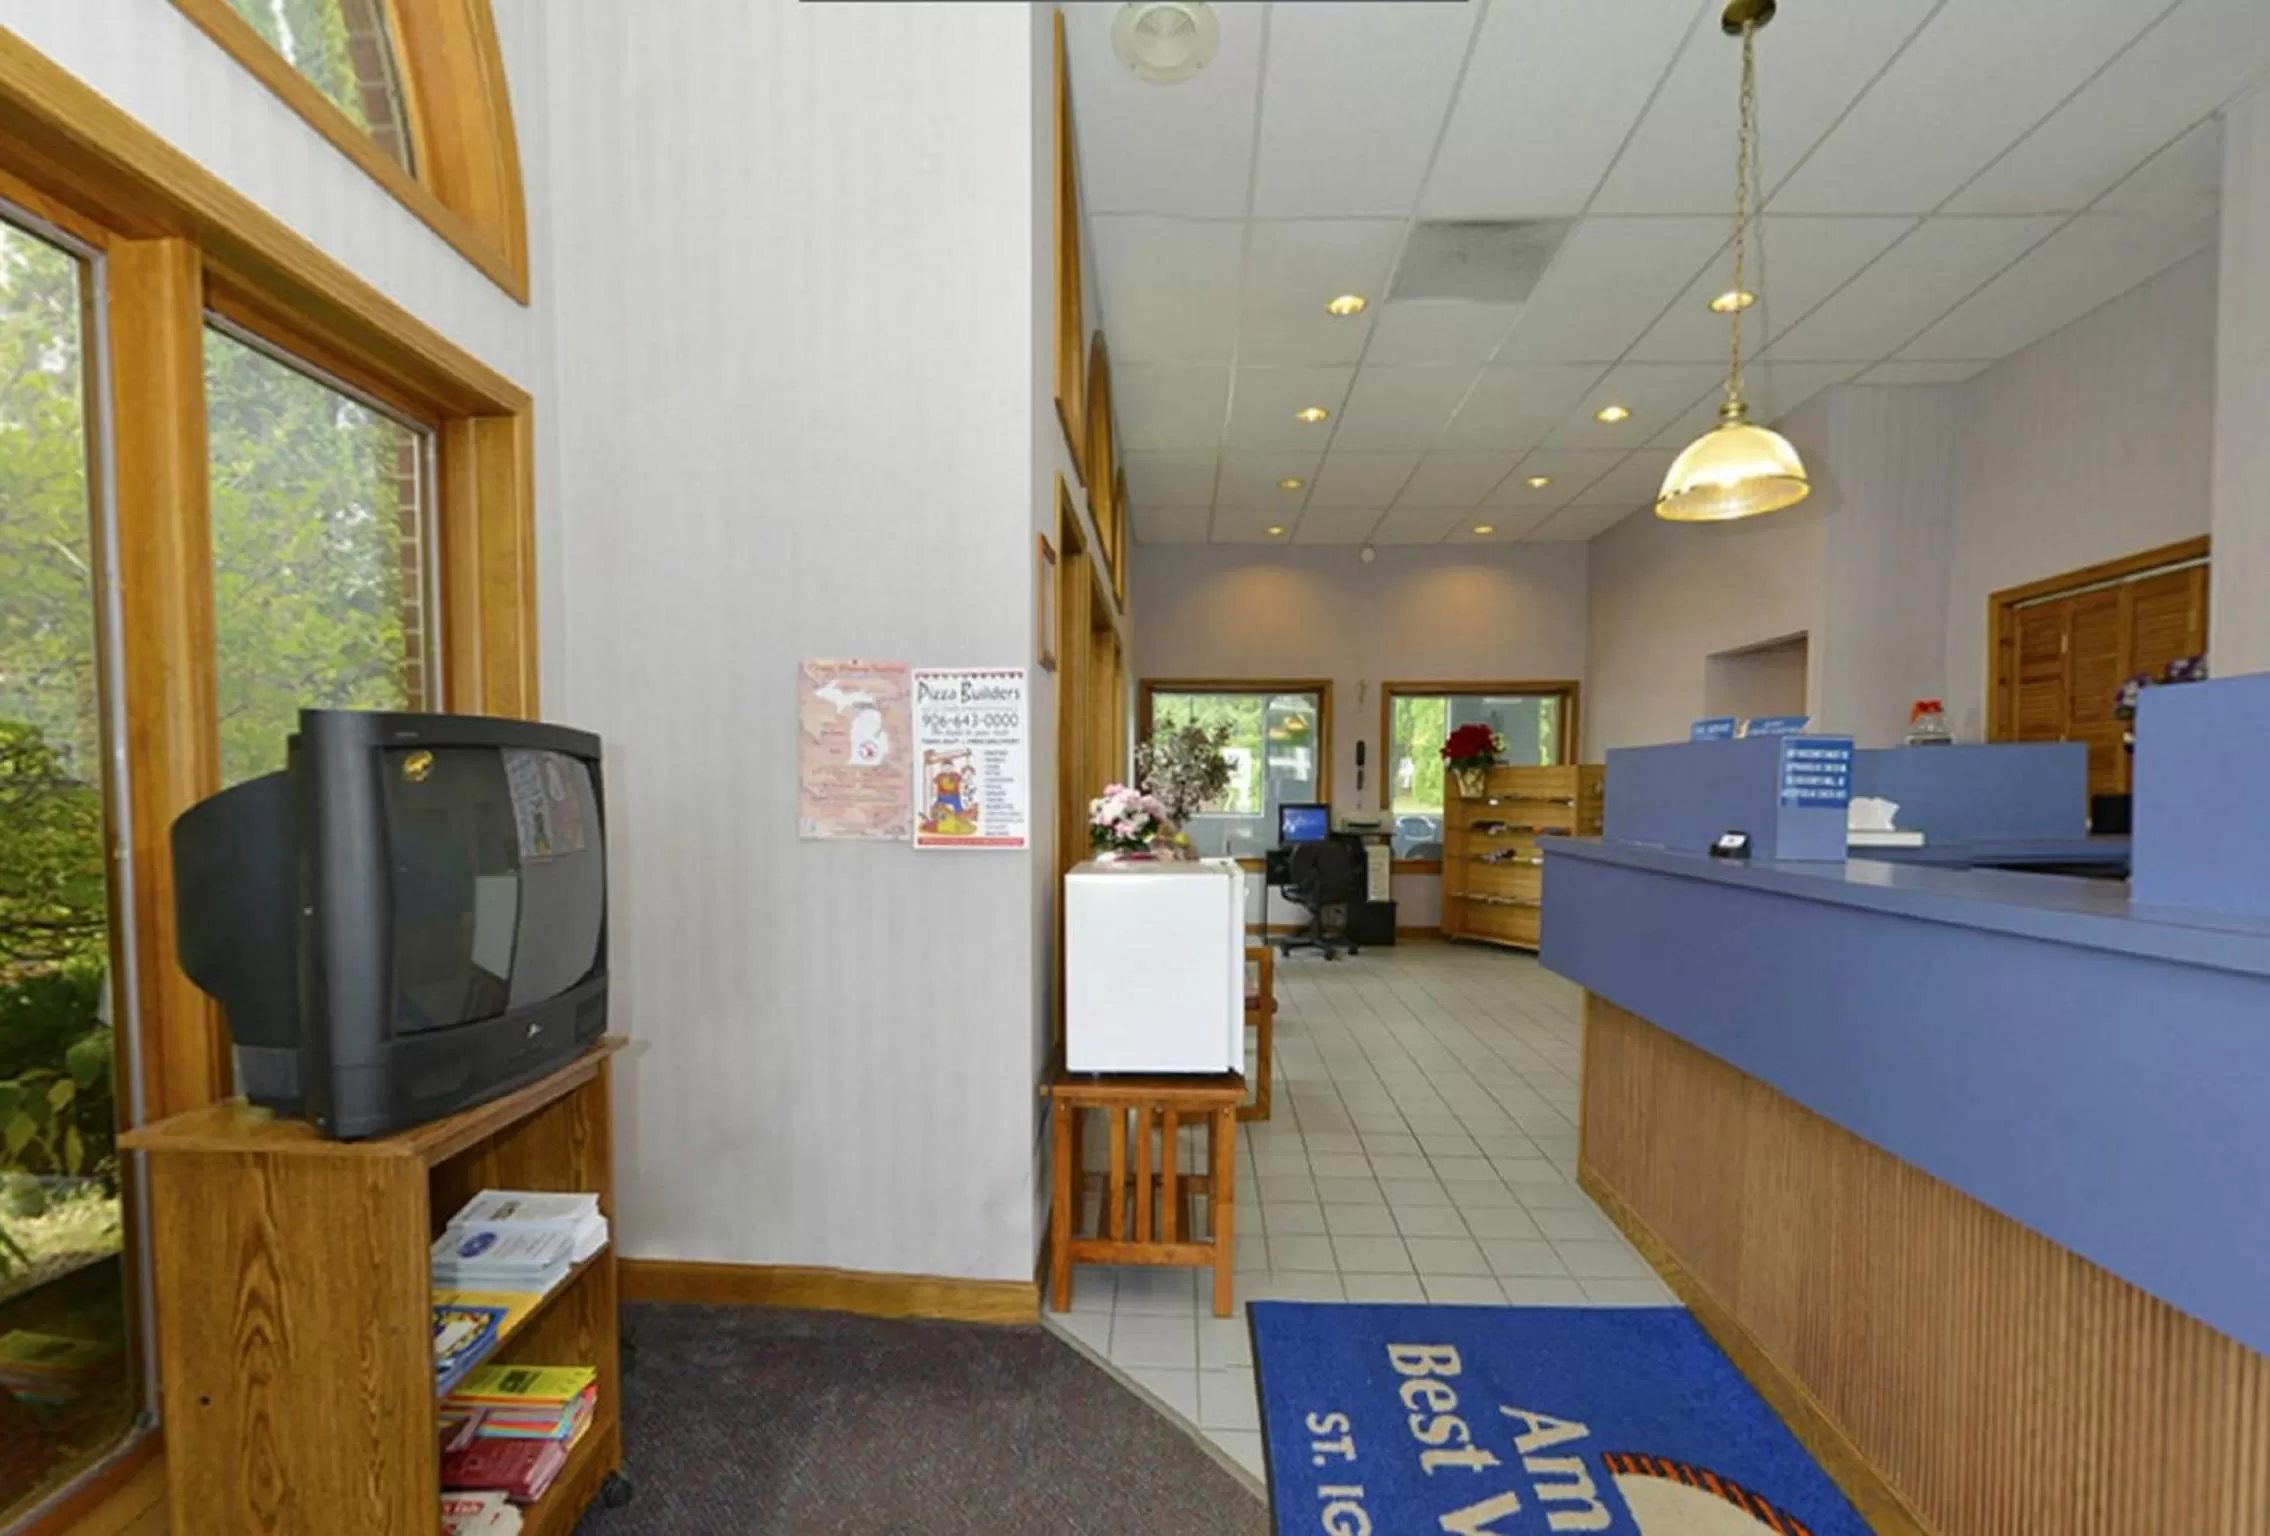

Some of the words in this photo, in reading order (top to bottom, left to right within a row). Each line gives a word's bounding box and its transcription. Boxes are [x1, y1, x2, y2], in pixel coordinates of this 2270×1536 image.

[918, 680, 957, 704] Pizza
[961, 681, 1020, 703] Builders
[921, 713, 1019, 728] 906-643-0000
[1387, 1343, 1501, 1476] Best
[1305, 1411, 1357, 1466] ST.
